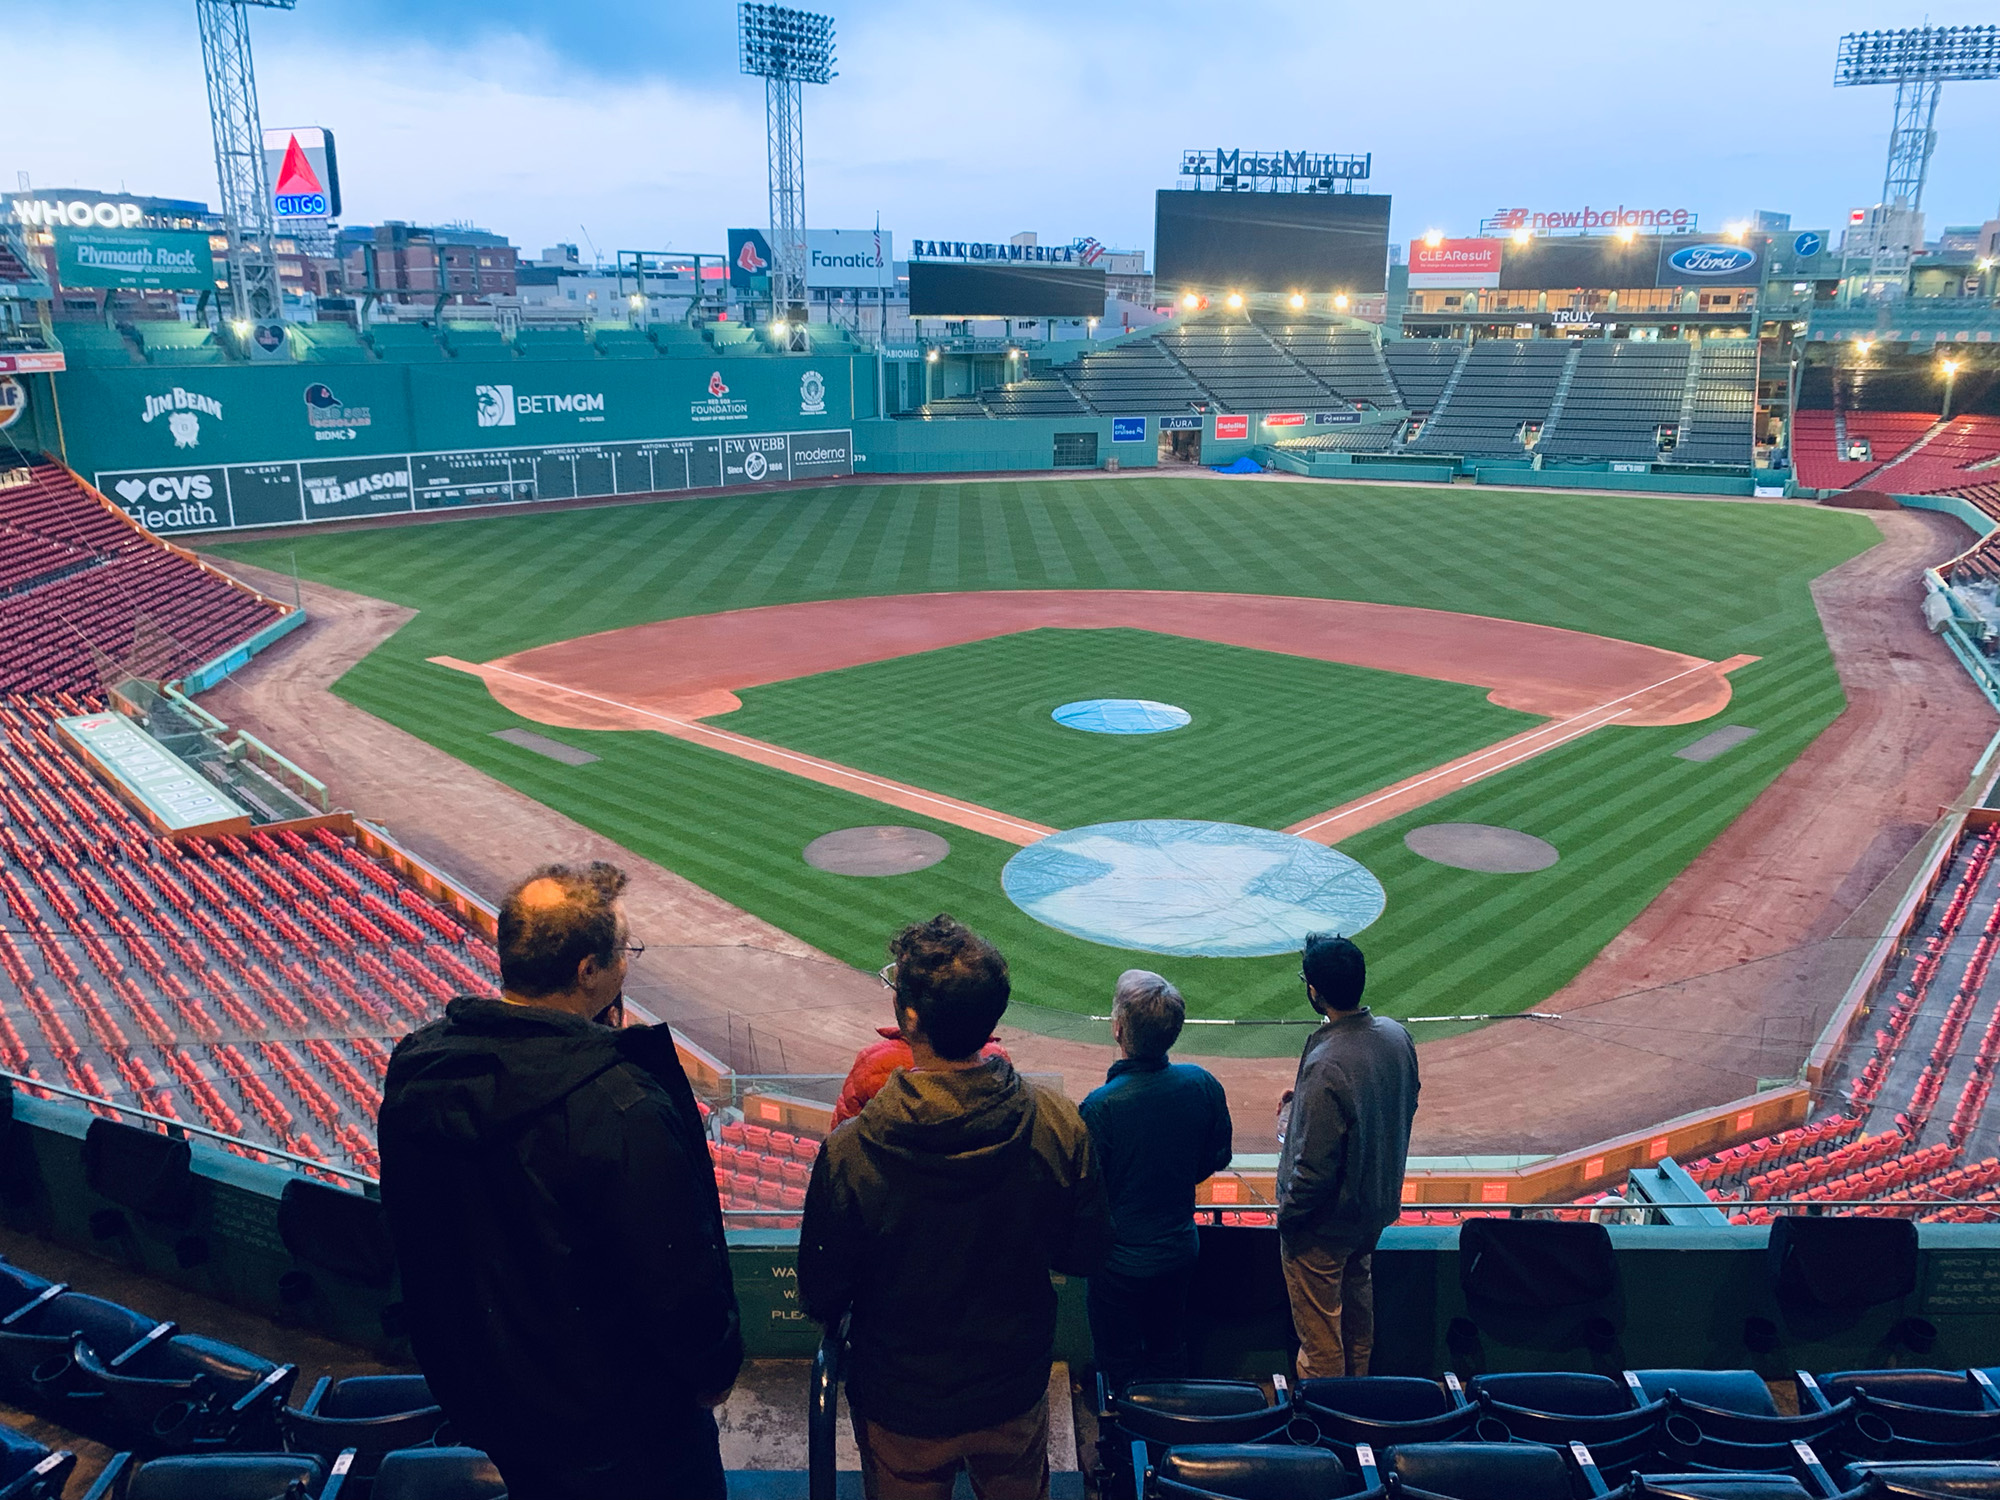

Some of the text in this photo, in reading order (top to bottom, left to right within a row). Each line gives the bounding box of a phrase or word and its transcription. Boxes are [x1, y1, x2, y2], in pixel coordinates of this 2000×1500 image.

[1217, 147, 1371, 179] MassMutual
[276, 194, 325, 214] CITGO
[12, 200, 141, 227] WHOOP
[1533, 205, 1689, 228] new balance
[77, 244, 195, 265] Plymouth Rock
[914, 239, 1073, 262] BANK OF AMERICA
[1418, 250, 1493, 261] CLEAResult
[1685, 248, 1738, 269] Ford
[1552, 312, 1594, 322] TRULY
[886, 350, 919, 359] ABIOMED
[142, 387, 223, 423] JIM BEAM
[517, 393, 604, 414] BETMGM
[691, 404, 748, 414] FOUNDATION
[315, 430, 346, 440] BIDMC
[543, 447, 575, 455] AMERICAN
[749, 437, 785, 451] WEBB
[795, 447, 845, 461] moderna
[854, 454, 866, 462] 379
[259, 466, 281, 474] EAST
[727, 466, 743, 474] Since
[148, 475, 213, 502] CVS
[122, 501, 217, 529] Health
[92, 729, 230, 822] FENWAY PARK
[771, 1266, 798, 1278] WA
